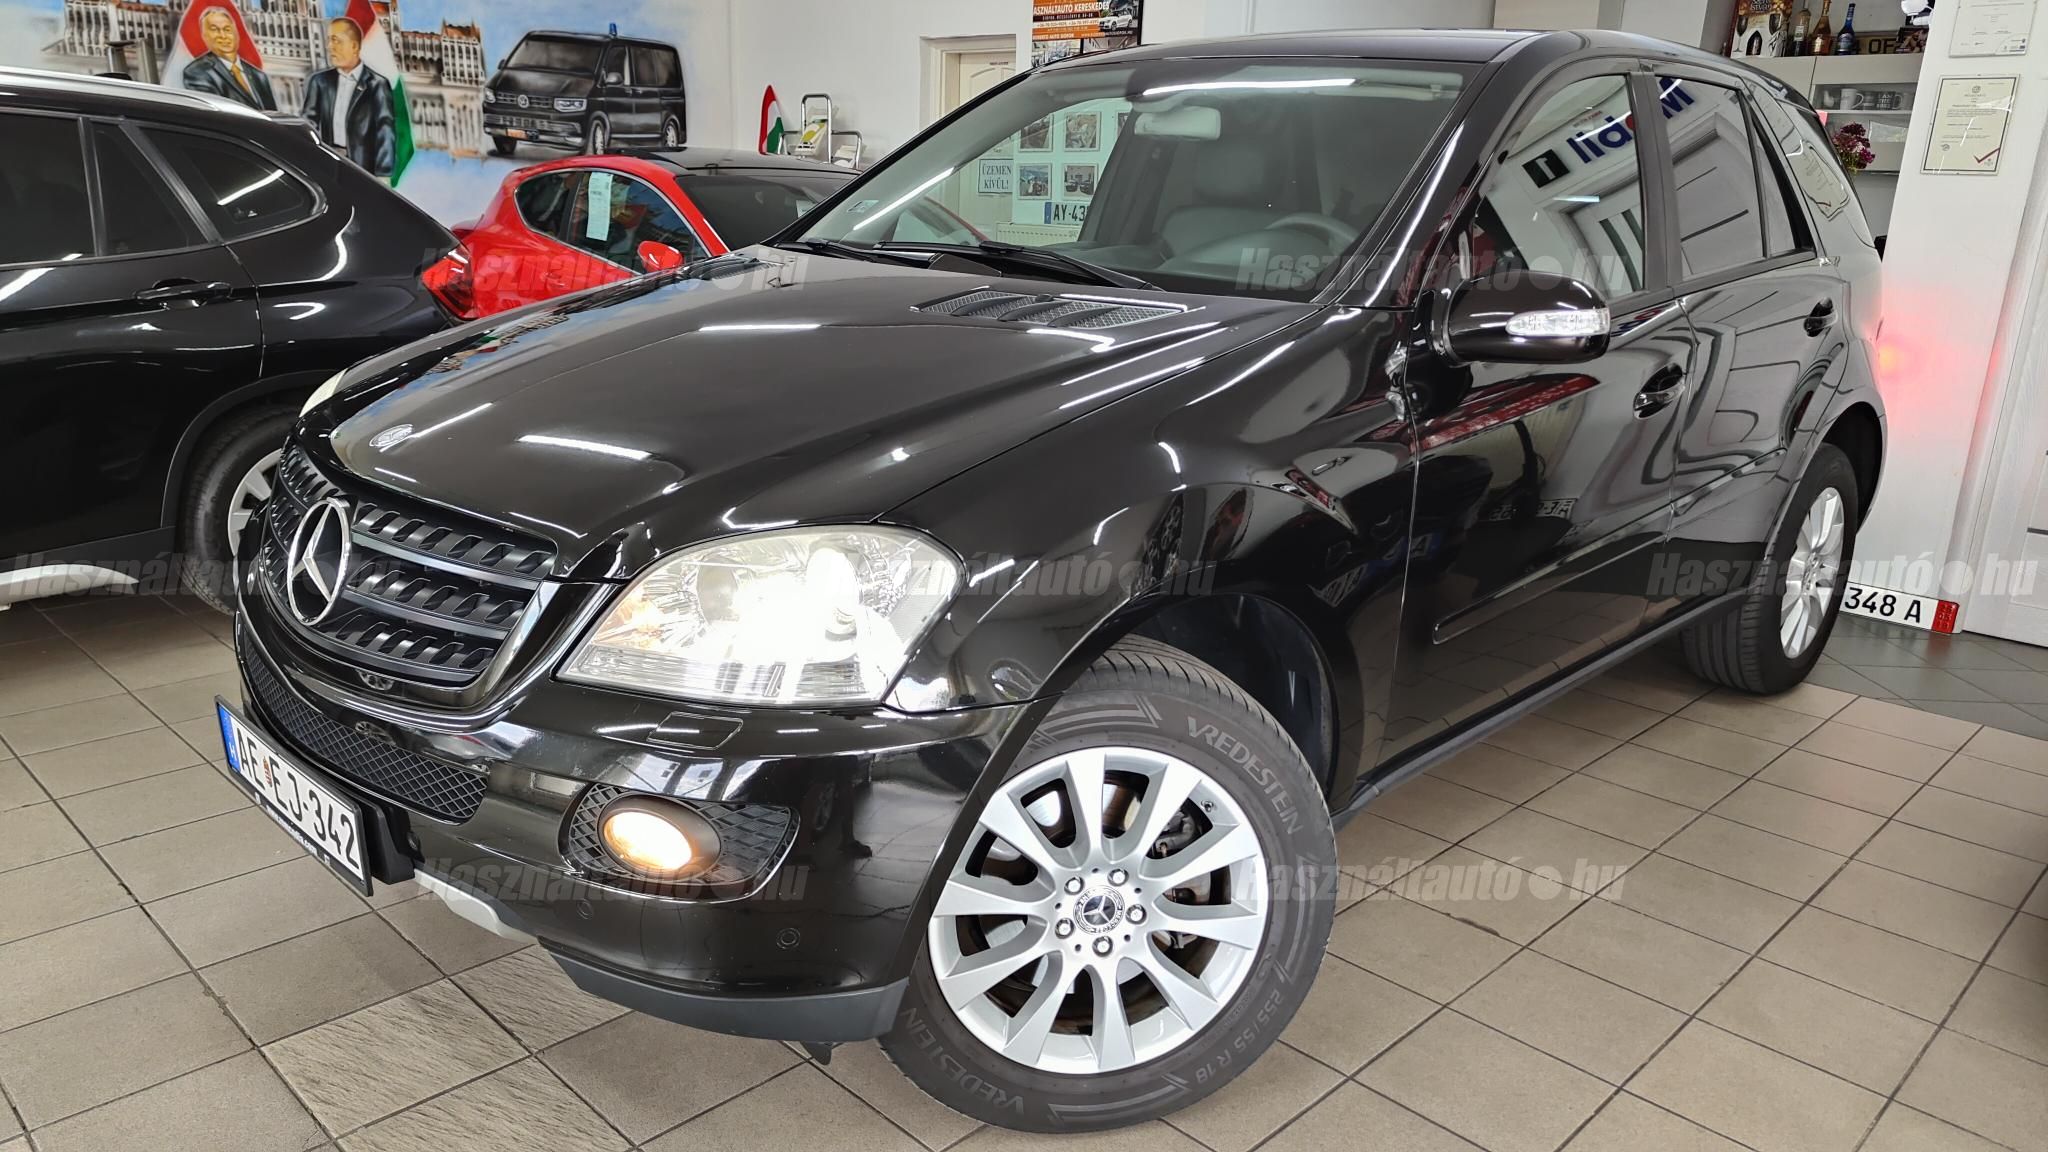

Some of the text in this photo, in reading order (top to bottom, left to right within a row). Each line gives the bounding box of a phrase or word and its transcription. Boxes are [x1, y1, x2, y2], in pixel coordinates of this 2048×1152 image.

[1053, 203, 1090, 222] AY-43
[1845, 587, 1897, 617] 348
[1903, 600, 1921, 623] A
[1186, 716, 1301, 836] VREDESTEIN
[236, 727, 266, 791] AE
[268, 755, 360, 870] EJ-342
[898, 1005, 1026, 1117] VREDESTEIN
[1195, 1066, 1217, 1084] 18
[1216, 1049, 1232, 1066] R
